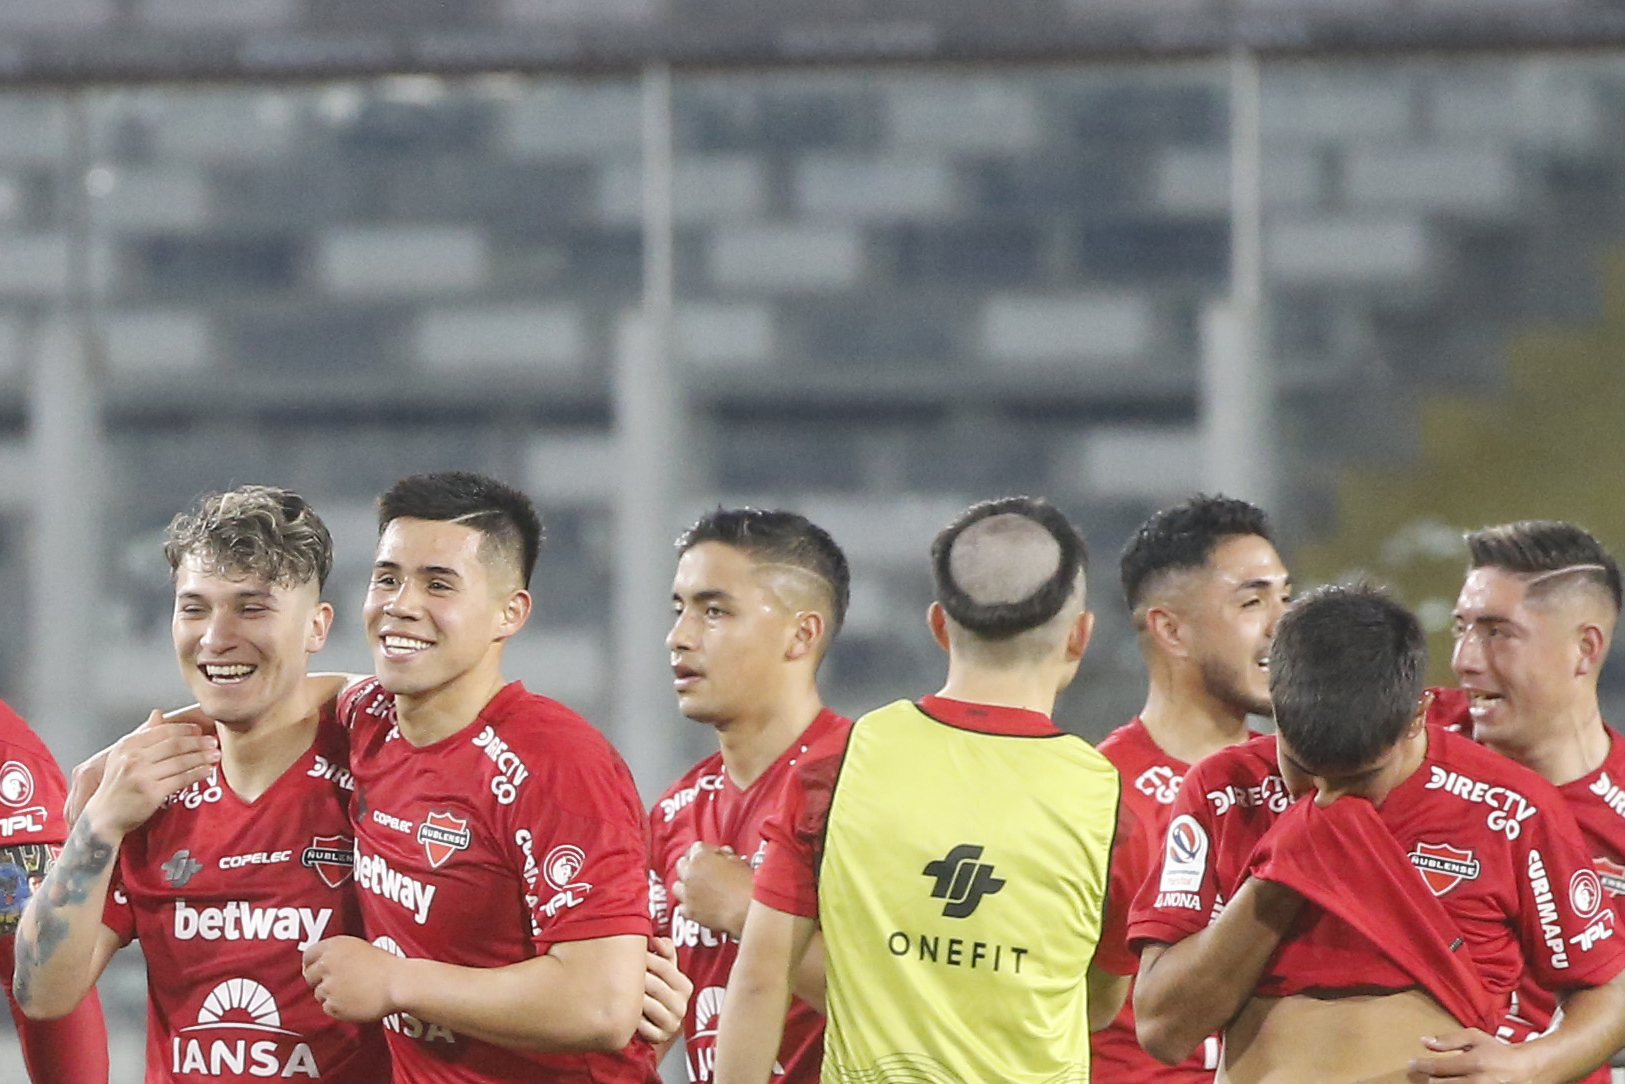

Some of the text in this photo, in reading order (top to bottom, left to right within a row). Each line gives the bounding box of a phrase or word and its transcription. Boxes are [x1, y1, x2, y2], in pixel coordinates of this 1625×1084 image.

[307, 755, 355, 791] DIRE
[184, 786, 222, 809] GO
[490, 776, 516, 804] GO
[1206, 776, 1284, 815] DIRECT
[1268, 792, 1295, 813] G
[1425, 766, 1537, 822] DIRECTV
[374, 810, 413, 834] COPELEC
[1487, 810, 1520, 840] GO
[219, 850, 293, 869] COPELEC
[307, 850, 353, 862] ÑUBLEN
[353, 837, 437, 925] betway
[174, 897, 333, 951] betway
[1528, 849, 1570, 969] CURIMAPU
[888, 931, 1029, 974] ONEFIT
[382, 1012, 455, 1043] NSA
[173, 1037, 320, 1078] IANSA
